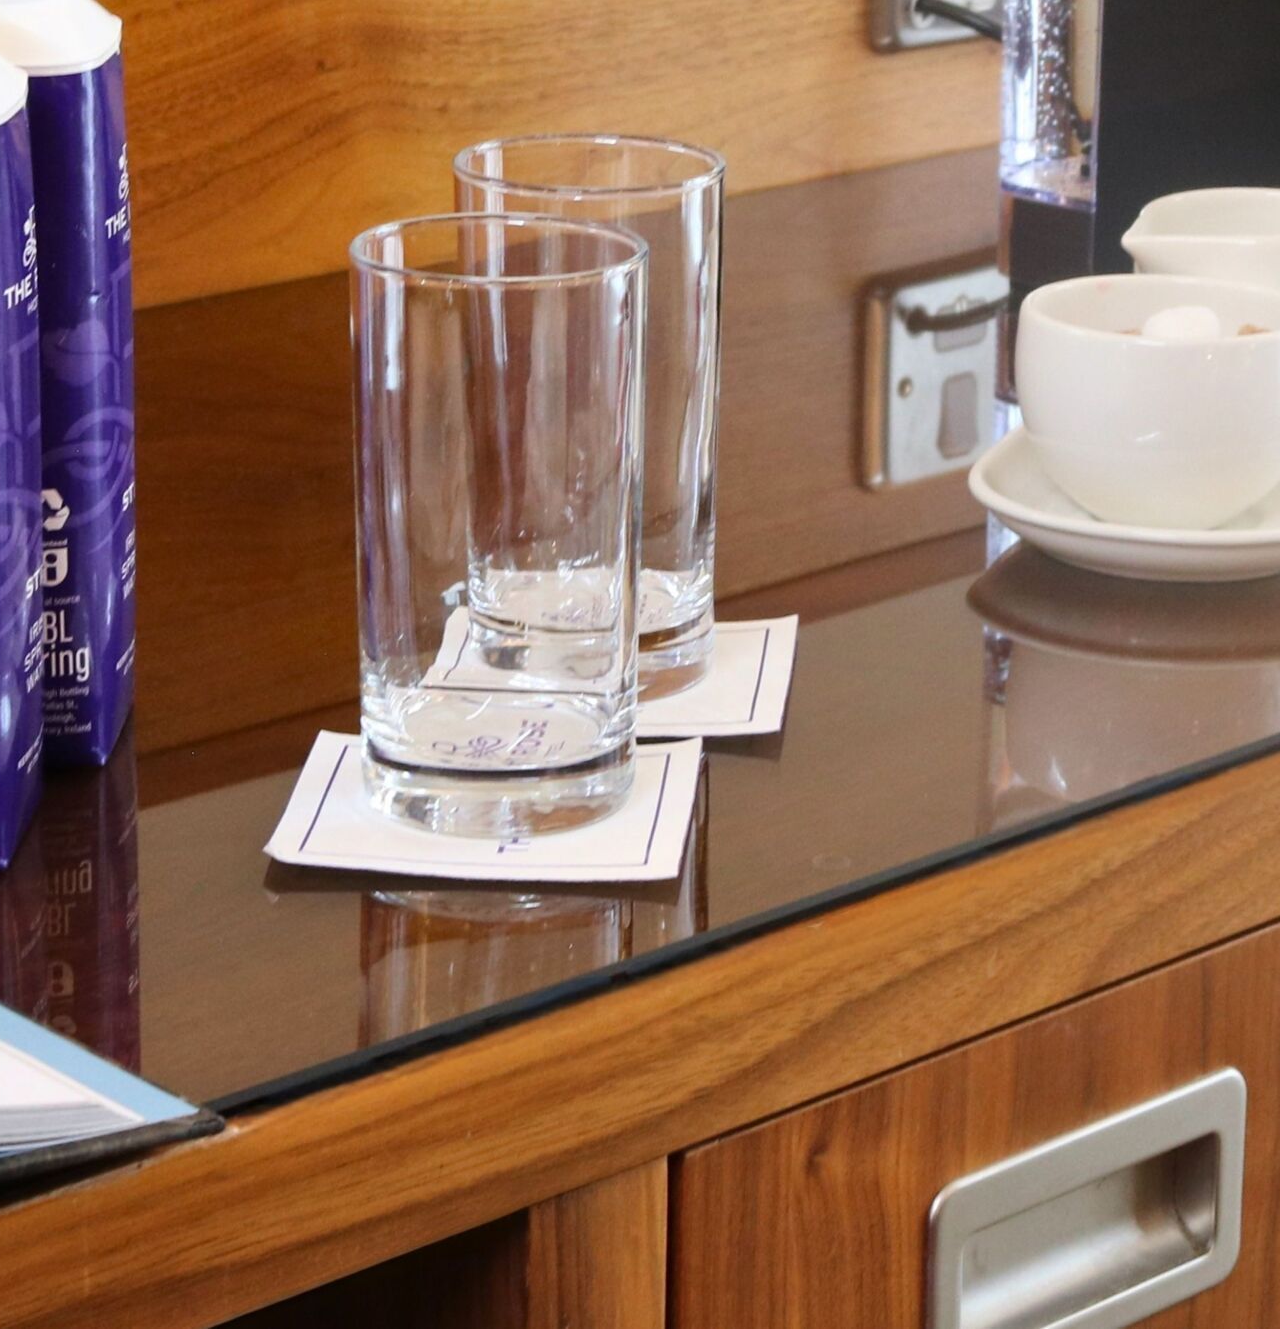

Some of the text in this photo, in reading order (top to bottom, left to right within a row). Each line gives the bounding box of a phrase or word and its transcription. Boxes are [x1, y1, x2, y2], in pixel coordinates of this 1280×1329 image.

[105, 205, 127, 240] THE
[4, 273, 33, 310] THE
[43, 610, 73, 645] BL
[43, 644, 91, 683] ring
